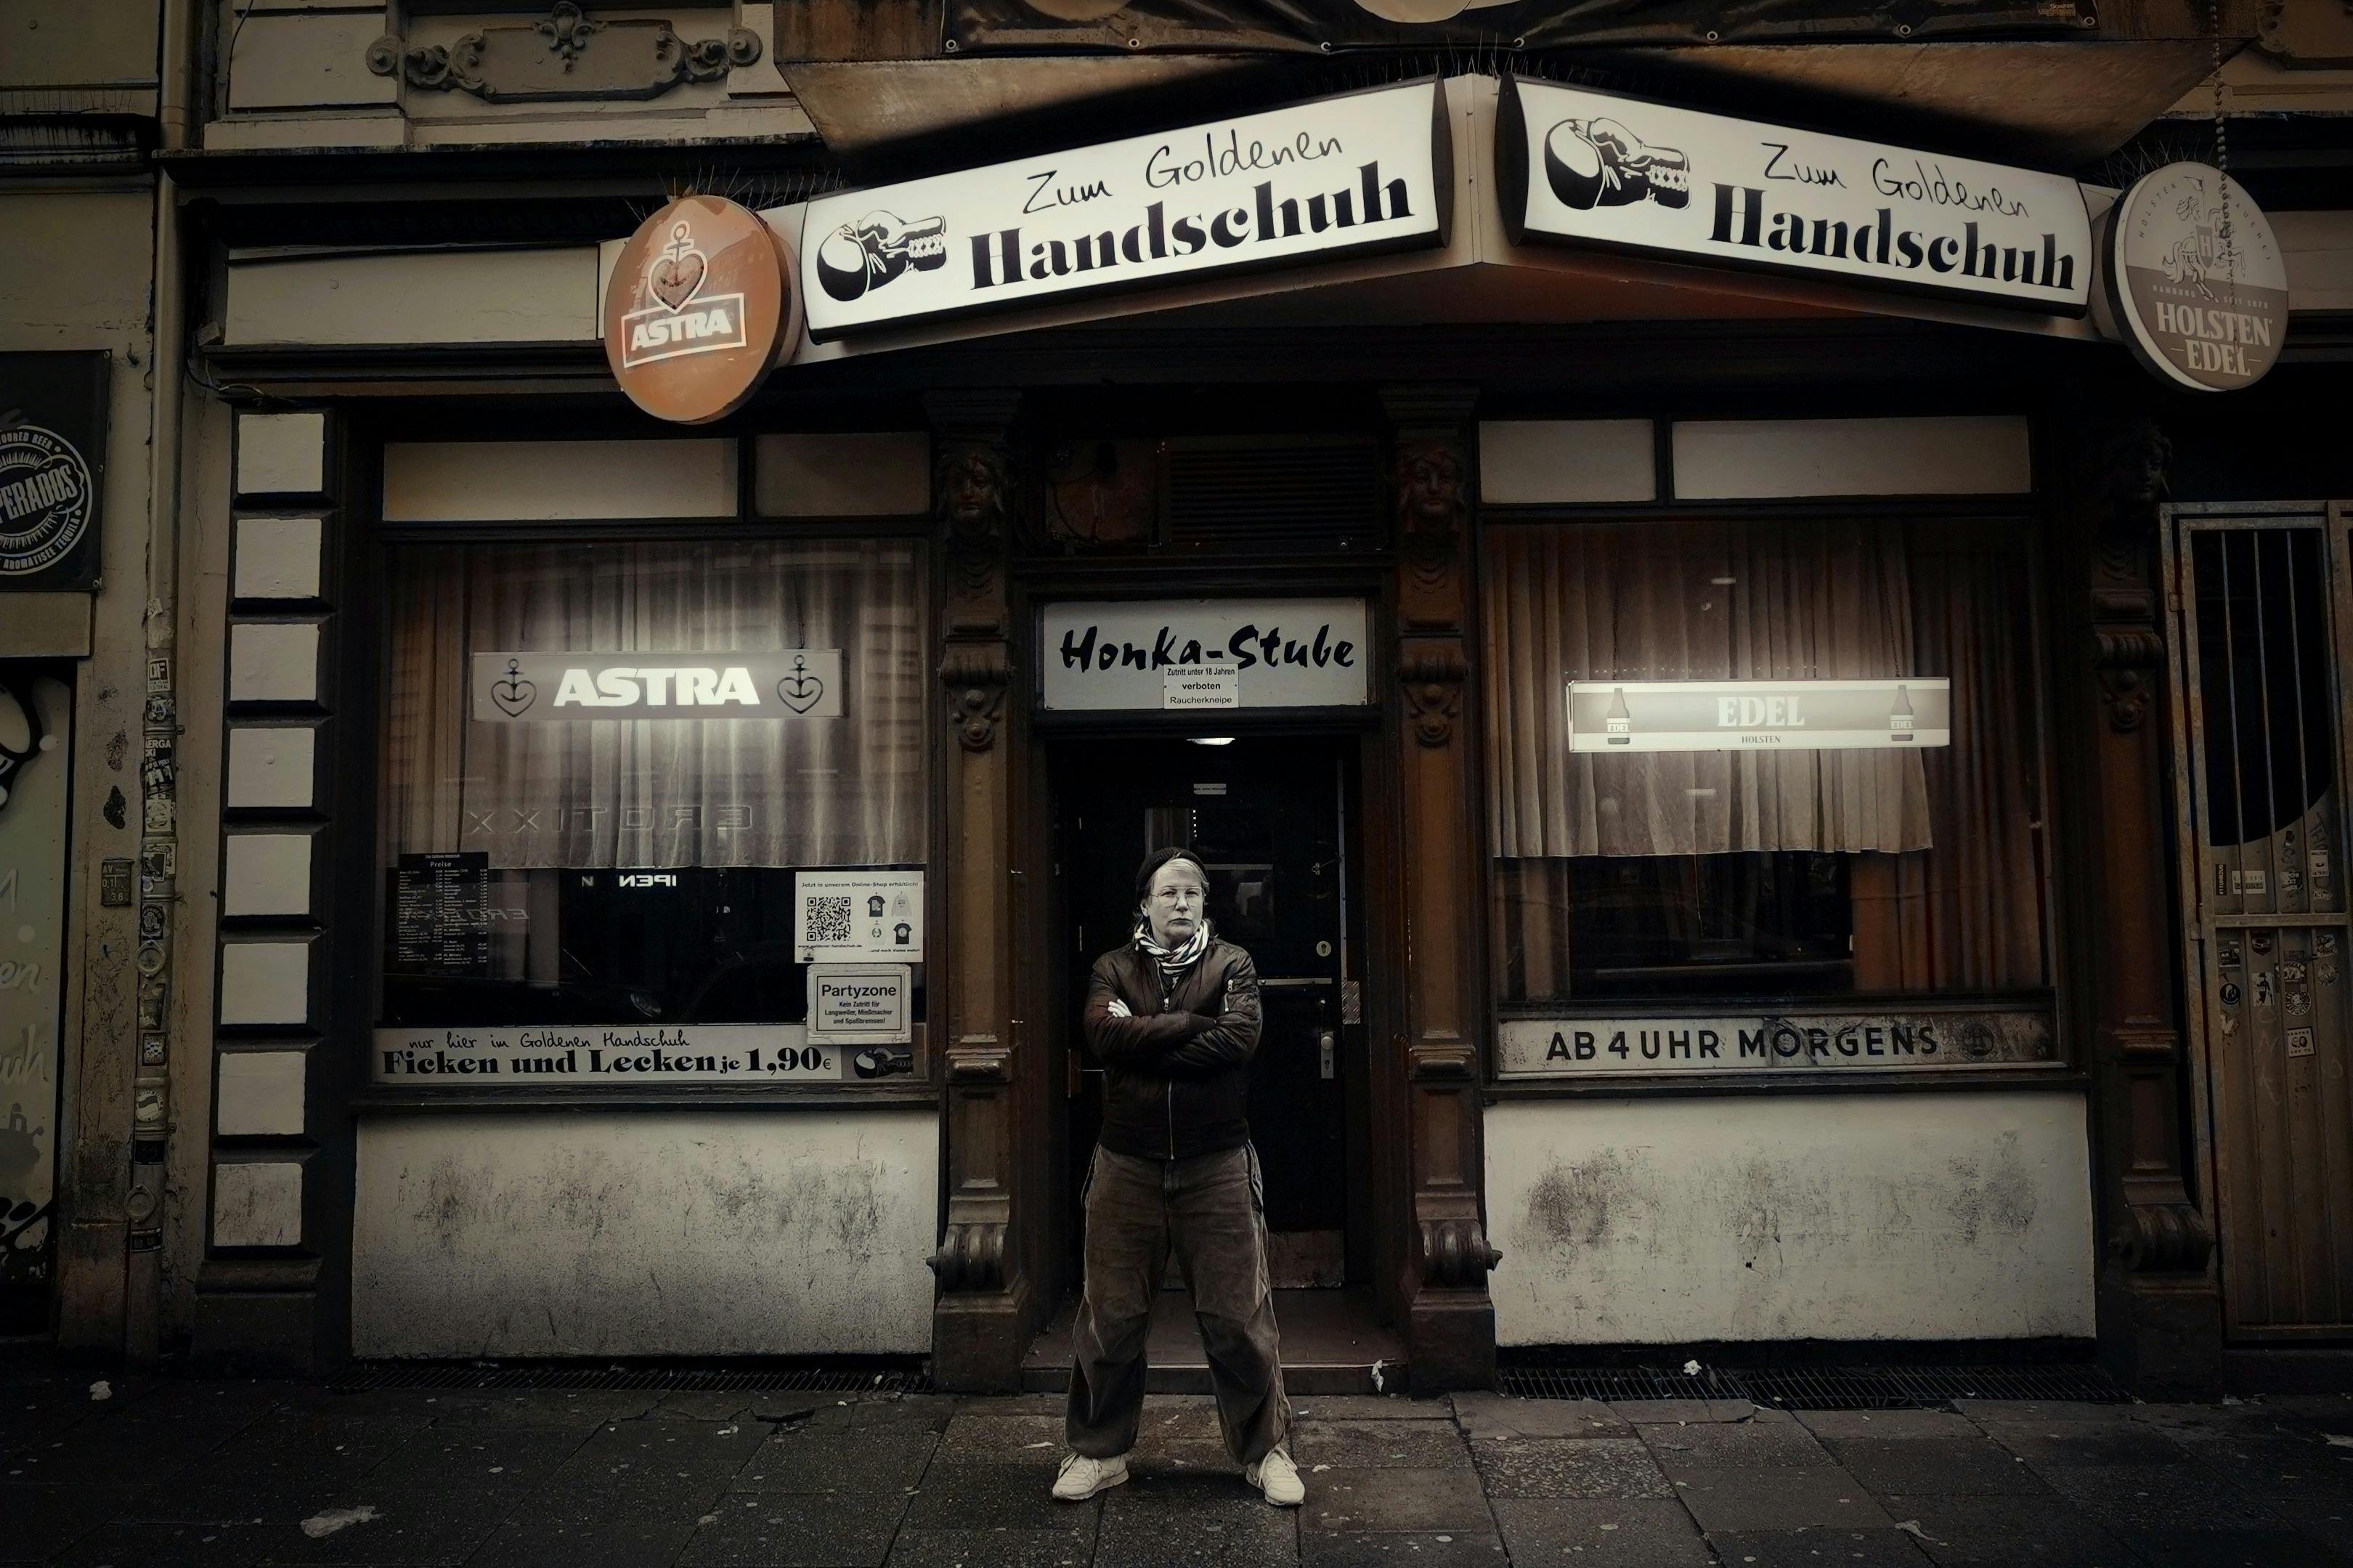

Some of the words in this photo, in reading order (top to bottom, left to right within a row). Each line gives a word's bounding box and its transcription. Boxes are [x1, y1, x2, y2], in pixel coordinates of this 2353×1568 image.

[1023, 171, 1111, 215] Zum
[1146, 129, 1341, 189] Goldenen
[1761, 142, 1845, 189] Zum
[1872, 158, 2029, 218] Goldenen
[968, 161, 1415, 291] Handschuh
[2139, 182, 2177, 238] HOLSTEN
[1707, 182, 2075, 290] Handschuh
[630, 309, 732, 352] ASTRA
[2155, 301, 2271, 347] HOLSTEN
[2185, 338, 2251, 376] EDEL
[0, 431, 29, 444] OURED
[31, 434, 53, 450] BEER
[1060, 625, 1354, 673] Honka-Stube
[553, 667, 760, 707] ASTRA
[1170, 696, 1232, 705] Raucherkneipe
[1718, 696, 1805, 727] EDEL
[1742, 735, 1781, 744] HOLSTEN
[821, 985, 897, 999] Partyzone
[409, 1039, 434, 1049] nur
[447, 1031, 477, 1049] hier
[490, 1035, 510, 1048] im
[521, 1031, 590, 1049] Goldenen
[604, 1030, 690, 1047] Handschuh
[1547, 1031, 1596, 1060] AB
[1608, 1031, 1630, 1059] 4
[1641, 1030, 1720, 1059] UHR
[1739, 1026, 1938, 1057] MORGENS
[382, 1050, 500, 1074] Ficken
[511, 1049, 578, 1073] und
[589, 1048, 717, 1074] Lecken
[720, 1055, 740, 1074] je
